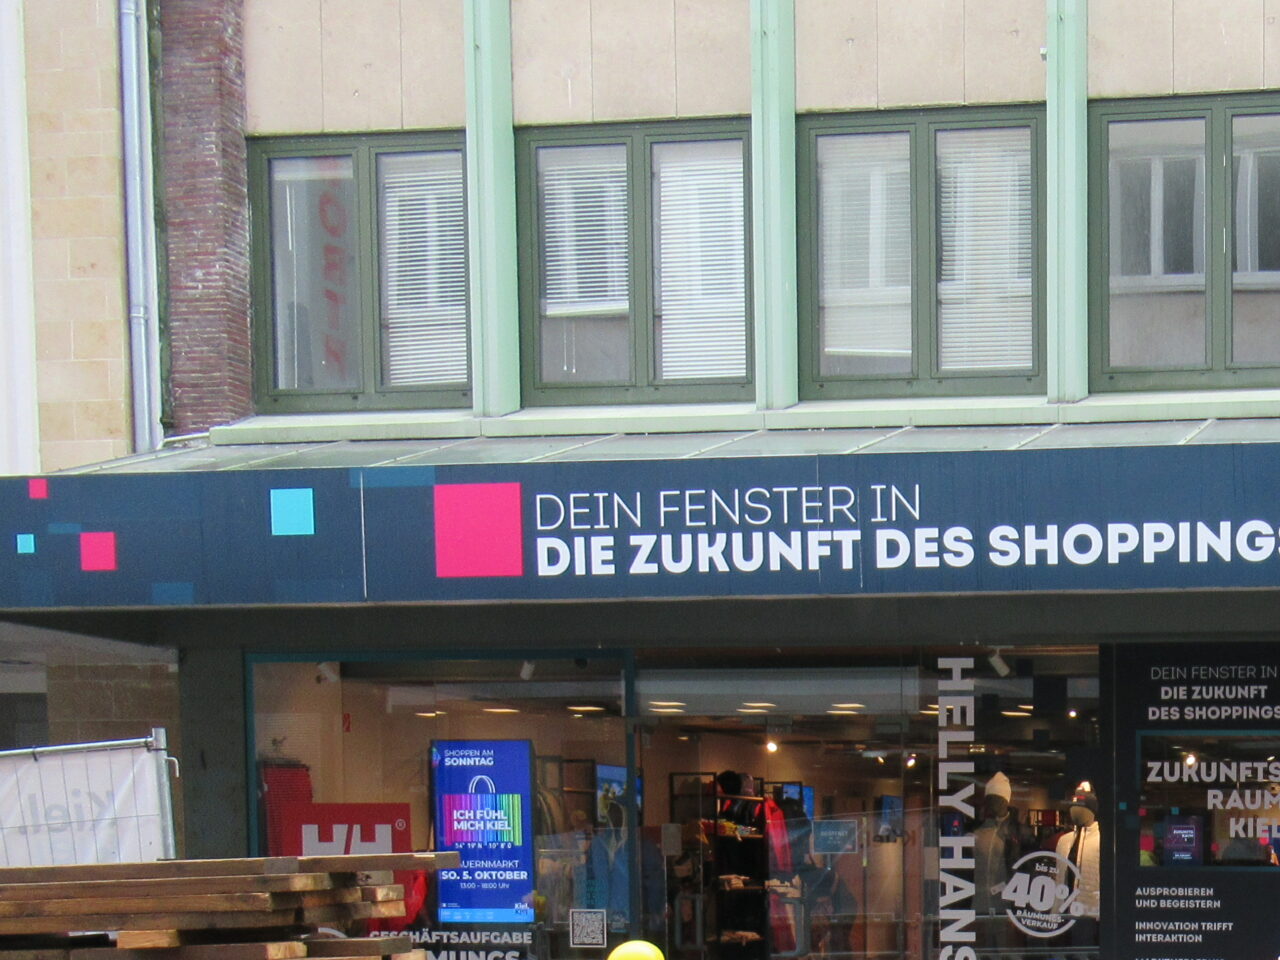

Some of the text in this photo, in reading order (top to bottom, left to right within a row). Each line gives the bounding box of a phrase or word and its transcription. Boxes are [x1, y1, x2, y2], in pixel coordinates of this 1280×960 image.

[535, 483, 920, 530] DEIN FENSTER IN
[536, 535, 616, 577] DIE
[628, 529, 861, 574] ZUKUNFT
[875, 526, 974, 569] DES
[1150, 665, 1278, 680] DEIN FENSTER IN
[1160, 685, 1268, 700] DIE ZUKUNFT
[1148, 706, 1181, 720] DES
[937, 657, 975, 819] HELLY
[444, 757, 494, 766] SONNTAG
[453, 808, 508, 819] ICH FÜHL
[453, 821, 512, 830] MICH KIEL
[460, 860, 519, 868] UERNMARKT
[1035, 862, 1048, 872] bis
[442, 871, 528, 879] SO. 5. OKTOBER
[1001, 872, 1085, 917] 40%
[1135, 887, 1214, 896] AUSPROBIEREN
[1135, 899, 1221, 908] UND BEGEISTERN
[1021, 918, 1059, 929] VERKAUF
[1135, 921, 1234, 931] INNOVATION TRIFFT
[1135, 933, 1202, 943] INTERAKTION
